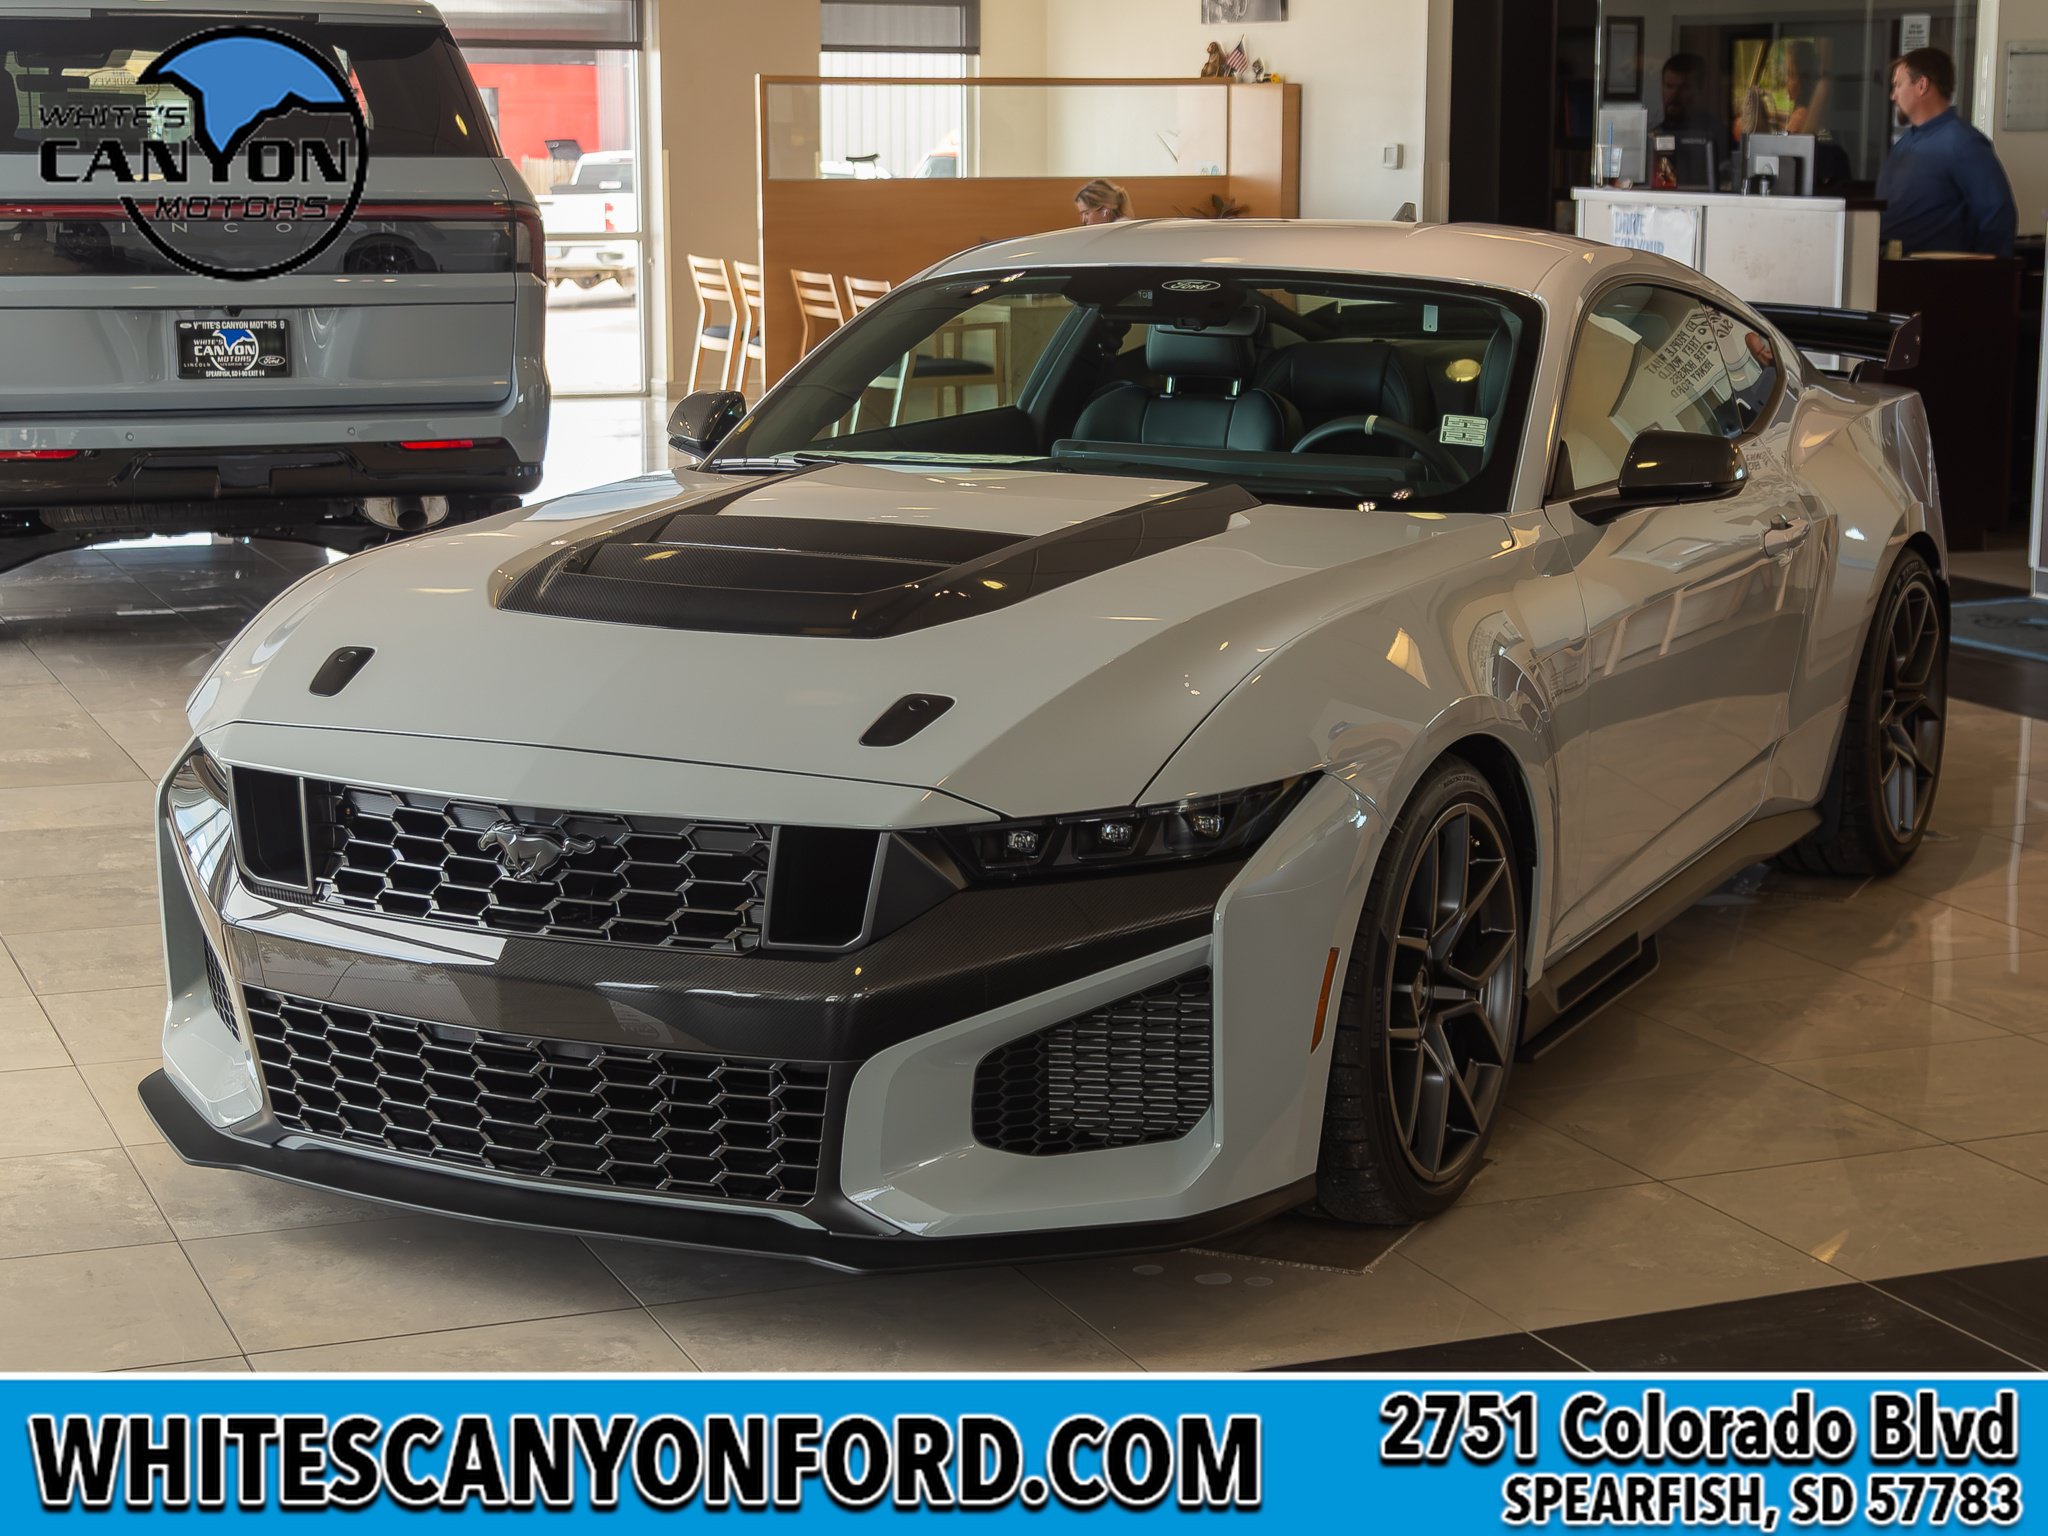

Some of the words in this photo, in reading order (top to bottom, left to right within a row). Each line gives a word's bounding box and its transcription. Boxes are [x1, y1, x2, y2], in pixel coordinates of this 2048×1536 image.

[58, 222, 397, 233] LINCON
[1166, 280, 1215, 291] Ford
[222, 321, 248, 329] CANYON
[194, 345, 256, 356] CANYON
